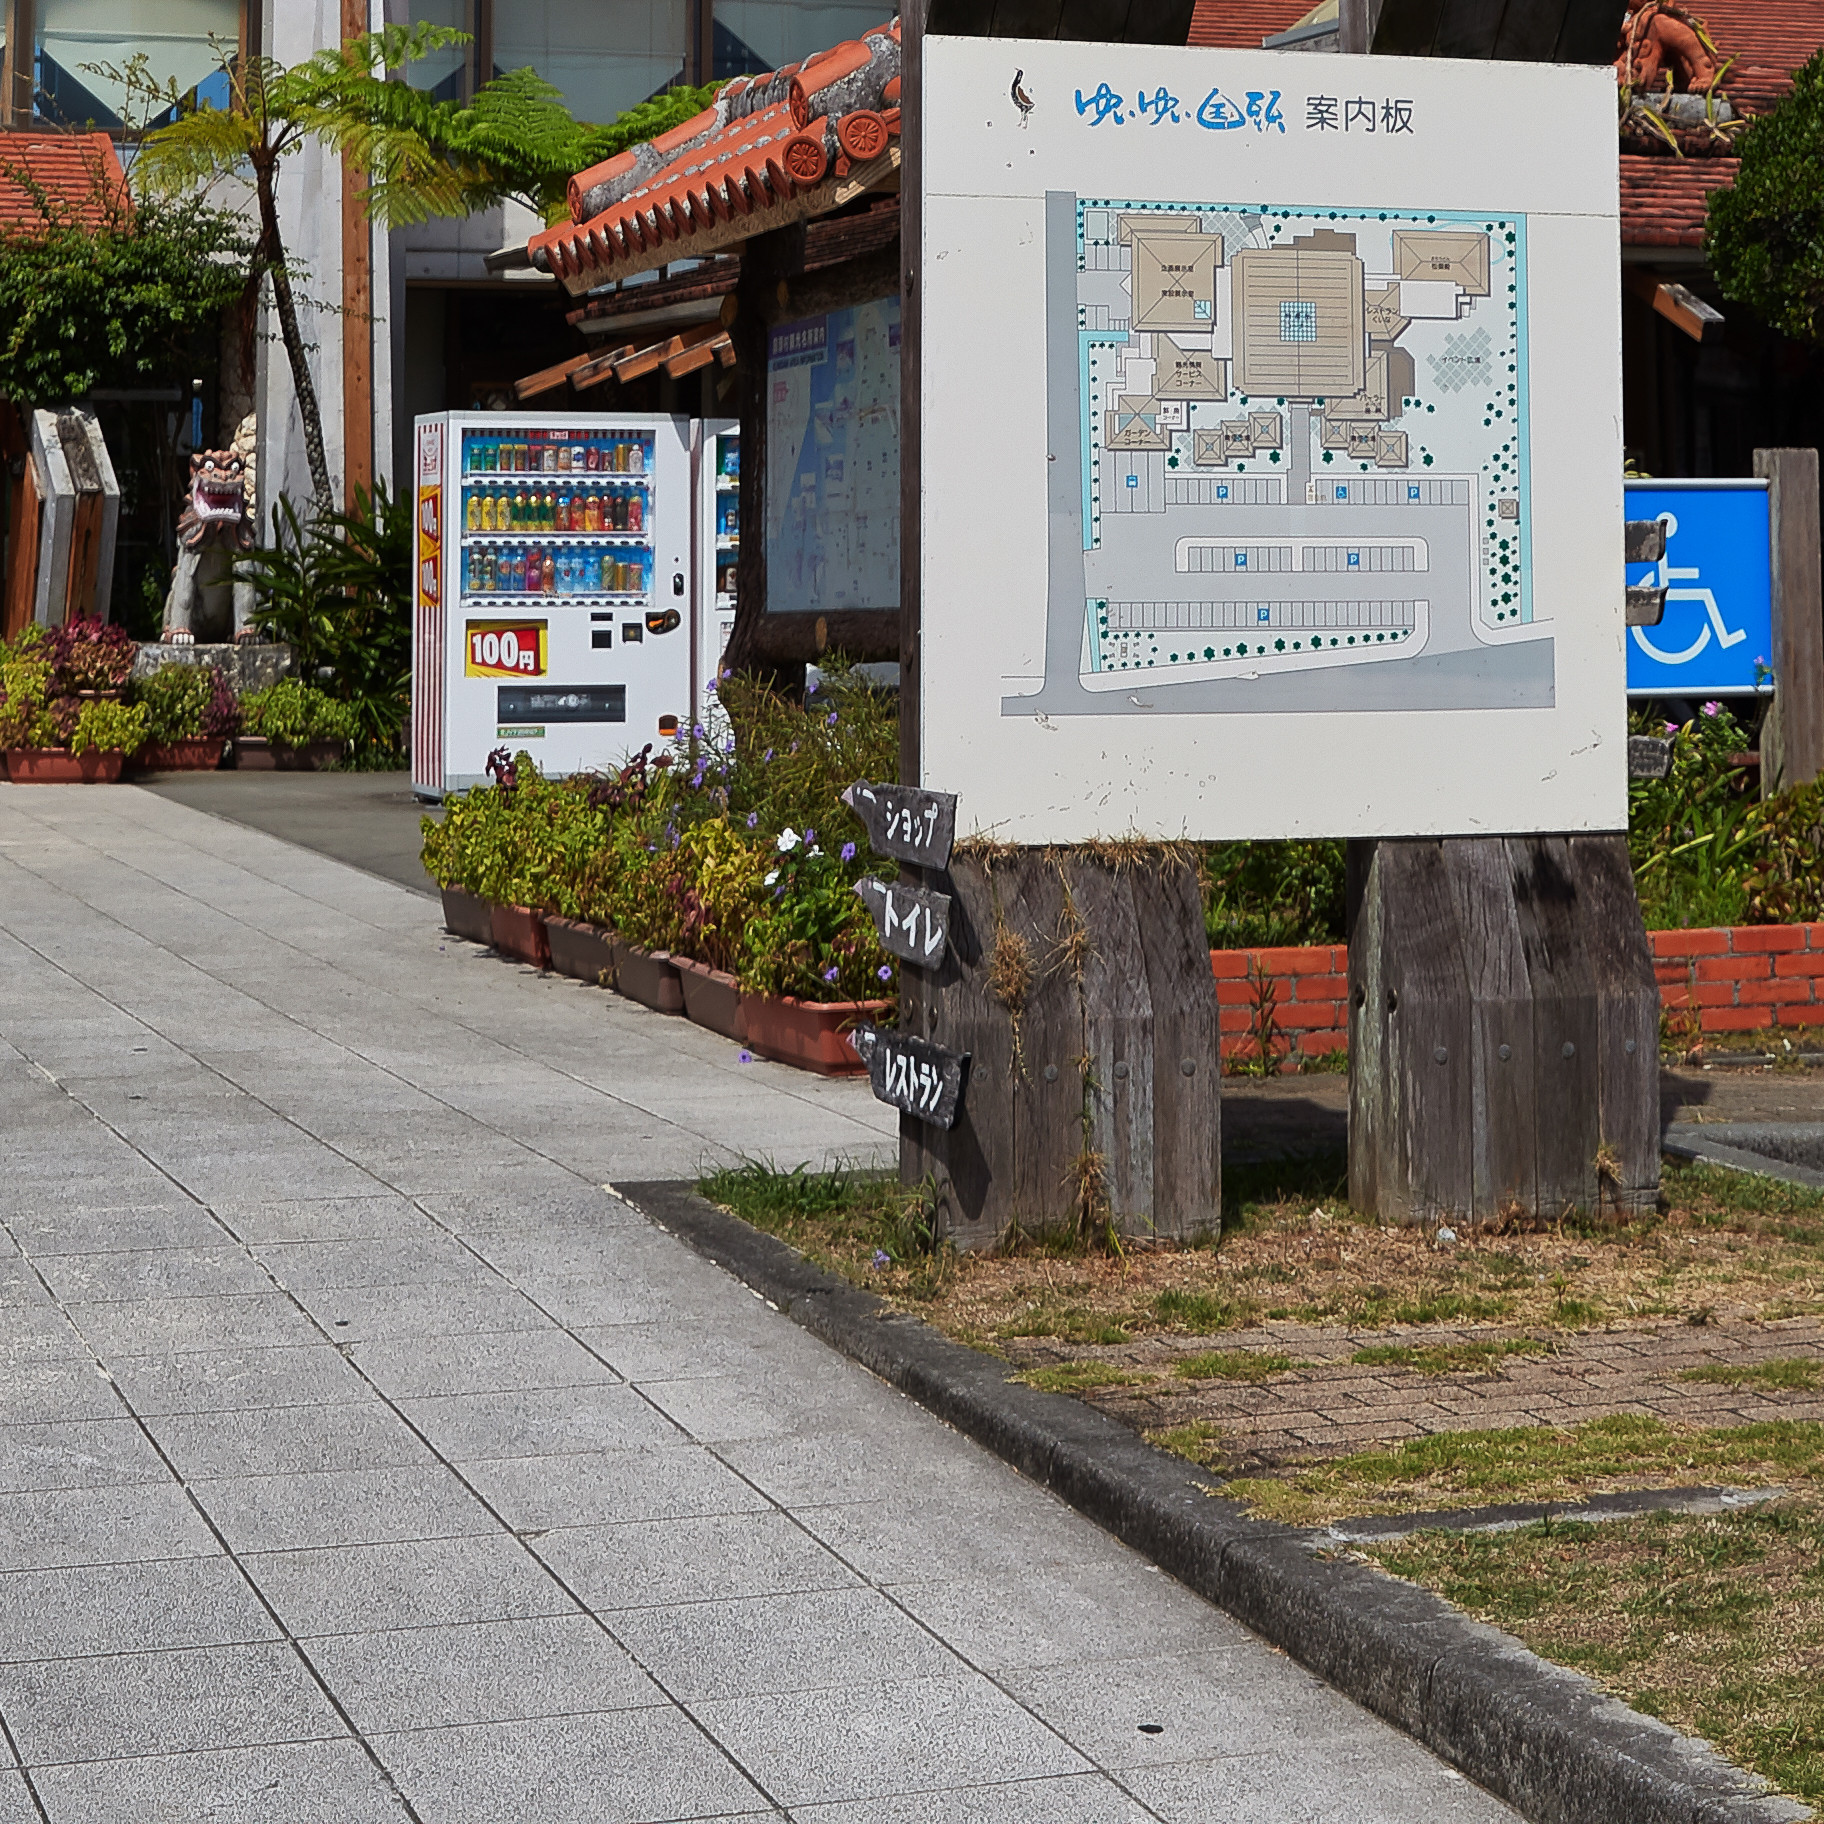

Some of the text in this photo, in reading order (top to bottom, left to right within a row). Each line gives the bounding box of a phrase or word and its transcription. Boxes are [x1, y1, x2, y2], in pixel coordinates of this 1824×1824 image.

[1305, 94, 1416, 135] 案内板
[1366, 306, 1399, 315] レストラン
[1175, 369, 1203, 378] サービス
[1175, 380, 1202, 388] コーナー
[472, 631, 536, 671] 100円
[885, 801, 939, 848] ショップ
[883, 889, 944, 957] トイレ
[884, 1047, 944, 1112] レストラン
